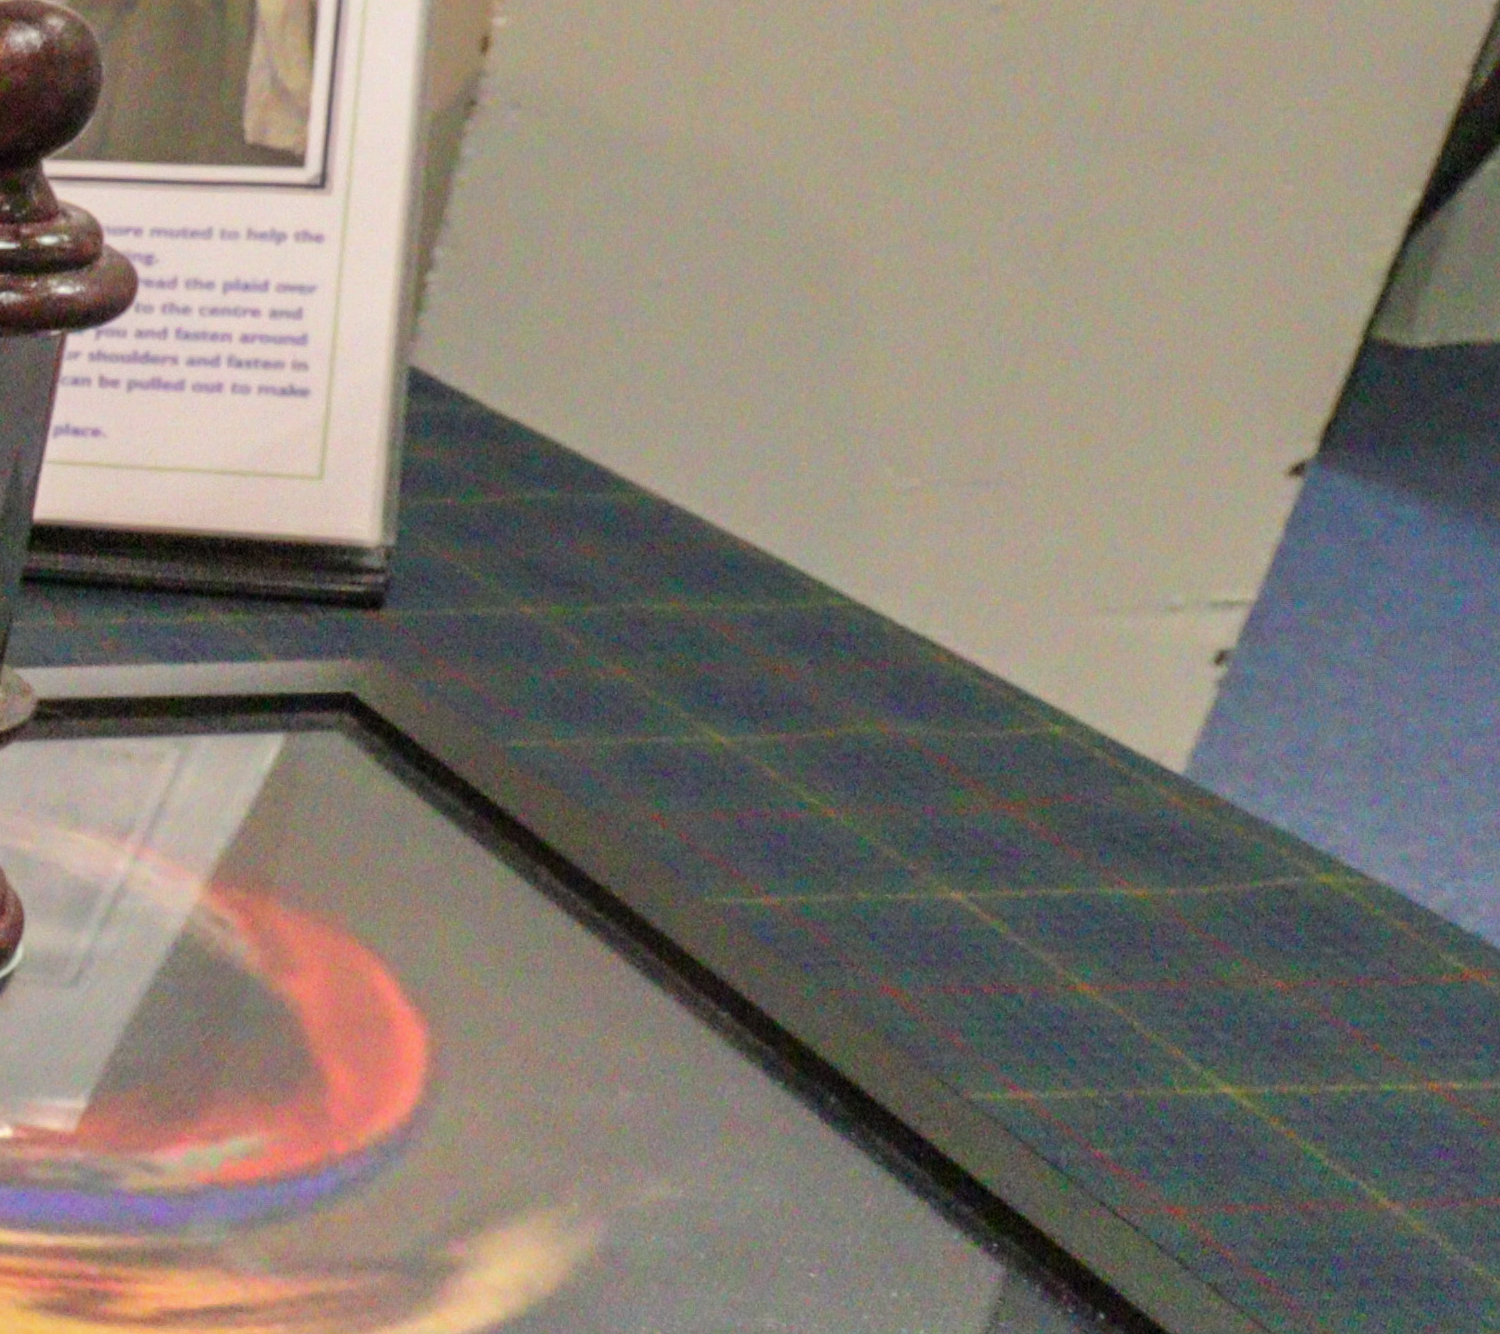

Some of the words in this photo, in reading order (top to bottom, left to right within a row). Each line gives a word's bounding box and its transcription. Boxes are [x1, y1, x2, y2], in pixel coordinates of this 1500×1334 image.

[150, 227, 213, 239] muted
[219, 228, 240, 240] to
[246, 227, 288, 245] help
[294, 228, 326, 244] the
[185, 278, 215, 291] the
[222, 279, 269, 295] plaid
[276, 283, 317, 293] over
[134, 303, 154, 315] to
[161, 302, 191, 315] the
[199, 306, 260, 318] centre
[269, 307, 303, 319] and
[94, 327, 127, 341] you
[134, 327, 168, 341] and
[175, 327, 232, 343] fasten
[239, 333, 308, 346] around
[88, 350, 178, 365] shoulders
[186, 355, 221, 367] and
[227, 356, 285, 370] fasten
[291, 359, 308, 371] in
[60, 375, 91, 387] can
[99, 376, 120, 389] be
[127, 377, 186, 393] pulled
[192, 381, 224, 393] out
[231, 383, 252, 395] to
[258, 385, 310, 398] make
